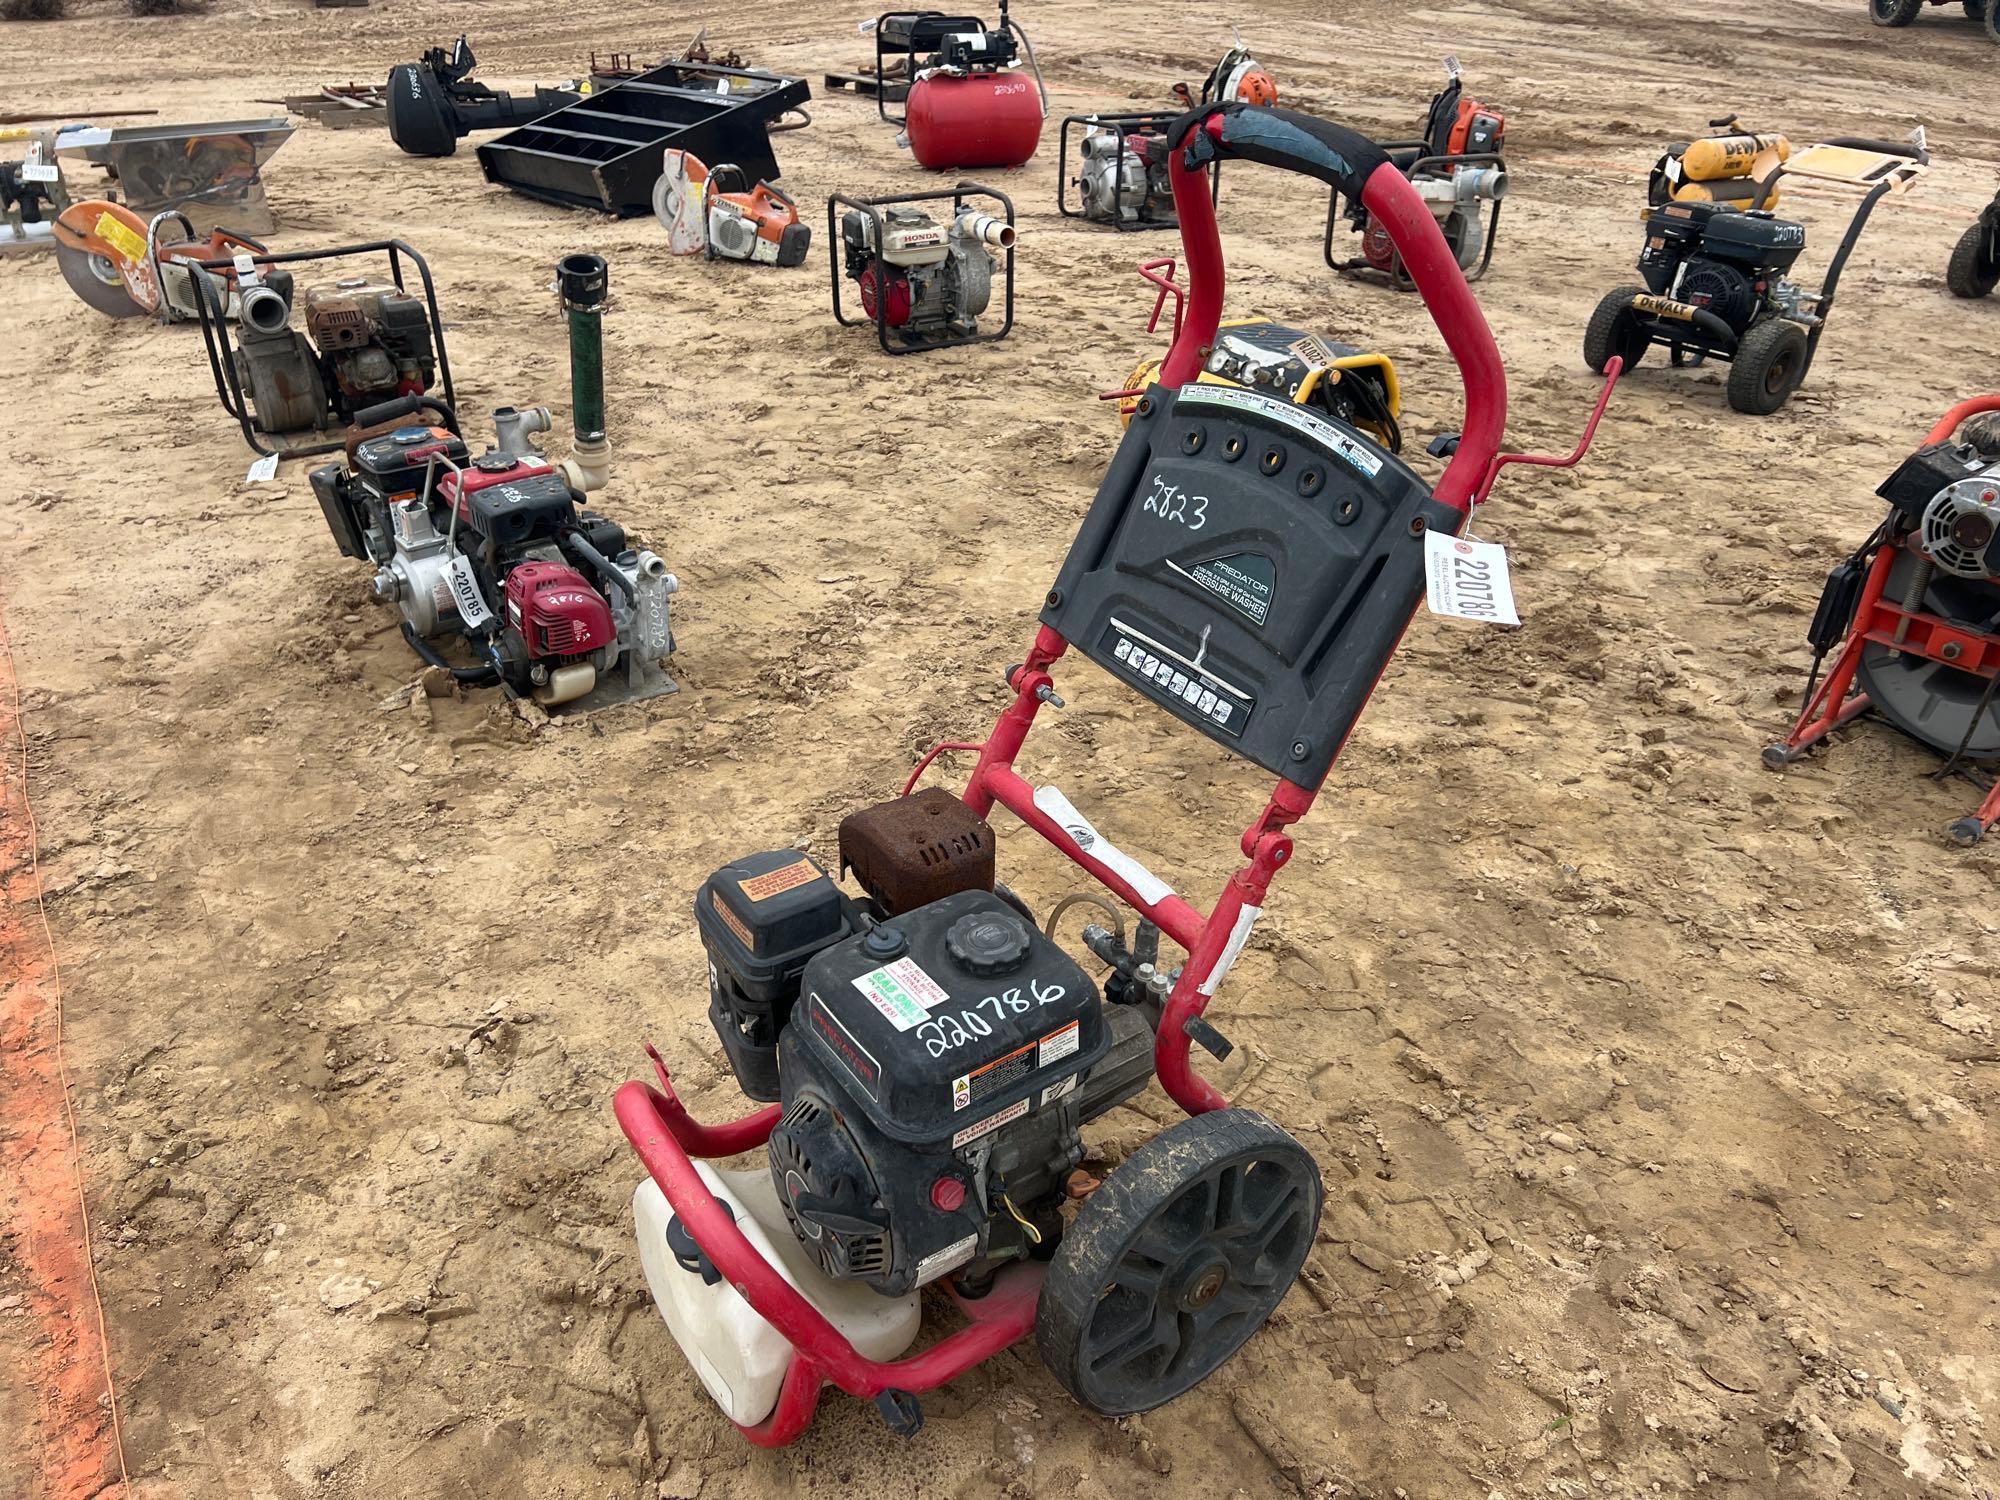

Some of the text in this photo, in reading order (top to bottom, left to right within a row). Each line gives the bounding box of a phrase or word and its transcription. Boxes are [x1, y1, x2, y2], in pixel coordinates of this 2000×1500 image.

[904, 233, 939, 242] HONDA
[1640, 297, 1688, 315] DEWALT
[1144, 475, 1209, 529] 2823
[456, 572, 483, 616] 220785
[1191, 569, 1265, 615] PRESSURE WASHER
[1214, 560, 1269, 594] PREDATOR
[1454, 558, 1497, 616] 220786
[648, 589, 665, 648] 220785
[873, 972, 897, 992] GAS
[894, 994, 926, 1018] ONLY
[958, 1130, 969, 1138] OIL
[971, 1116, 994, 1132] EVERY
[1001, 1102, 1025, 1116] HOURS
[966, 1126, 988, 1139] VOIDS
[988, 1106, 1026, 1128] WARRANTY
